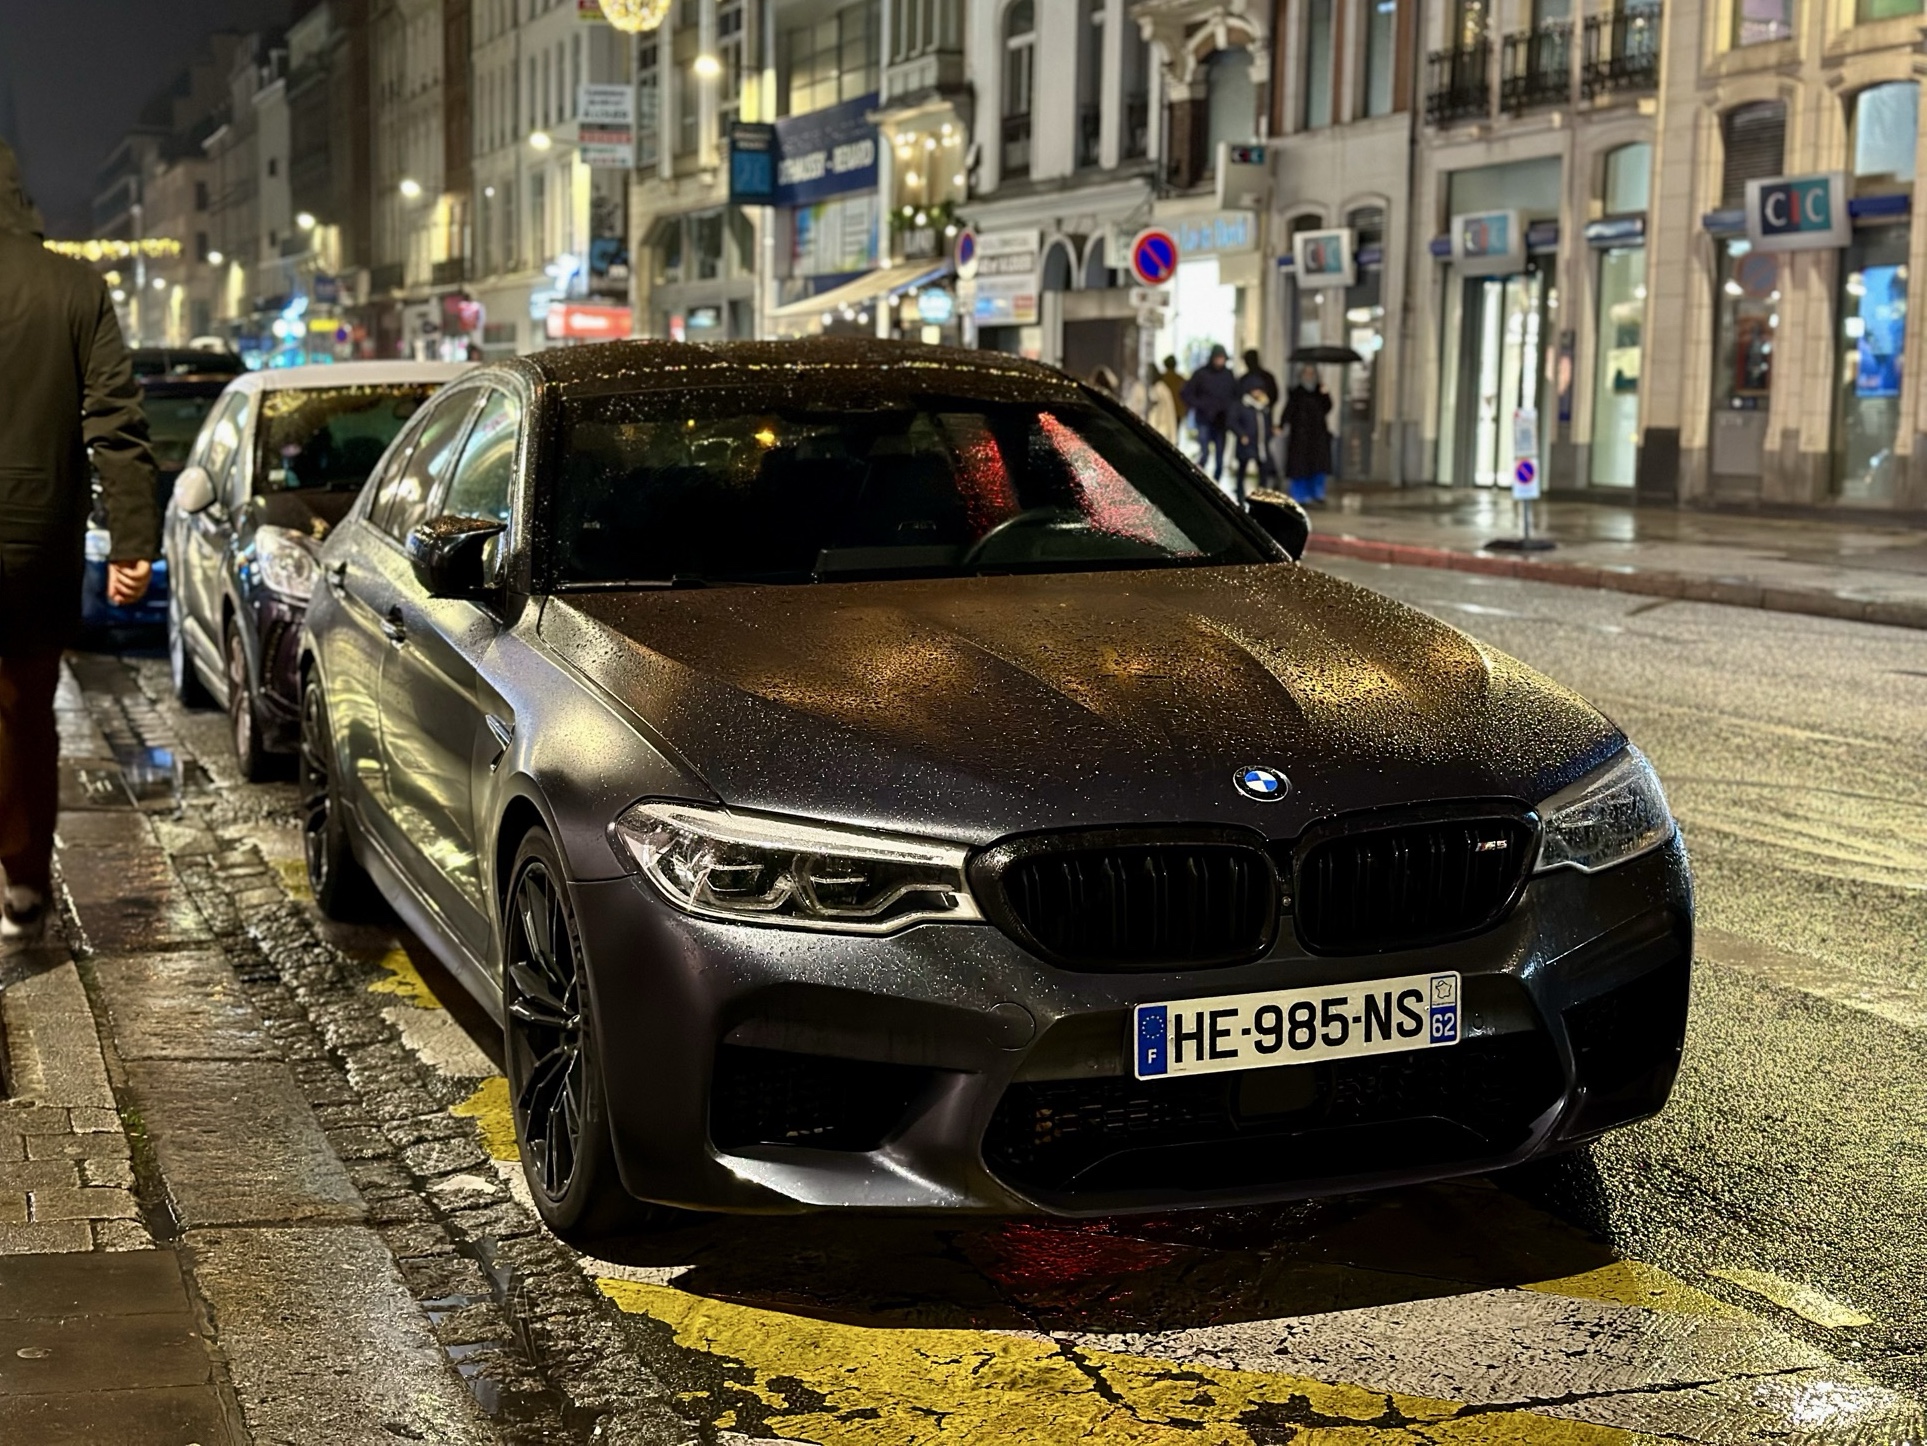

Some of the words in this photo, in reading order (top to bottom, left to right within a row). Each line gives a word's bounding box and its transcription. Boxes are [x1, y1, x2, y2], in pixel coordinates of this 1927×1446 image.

[1764, 187, 1825, 227] CIC
[1465, 222, 1504, 251] CIC
[1305, 240, 1339, 270] CIC
[1174, 988, 1425, 1064] HE-985-NS
[1431, 1011, 1456, 1038] 62
[1147, 1048, 1158, 1065] F
